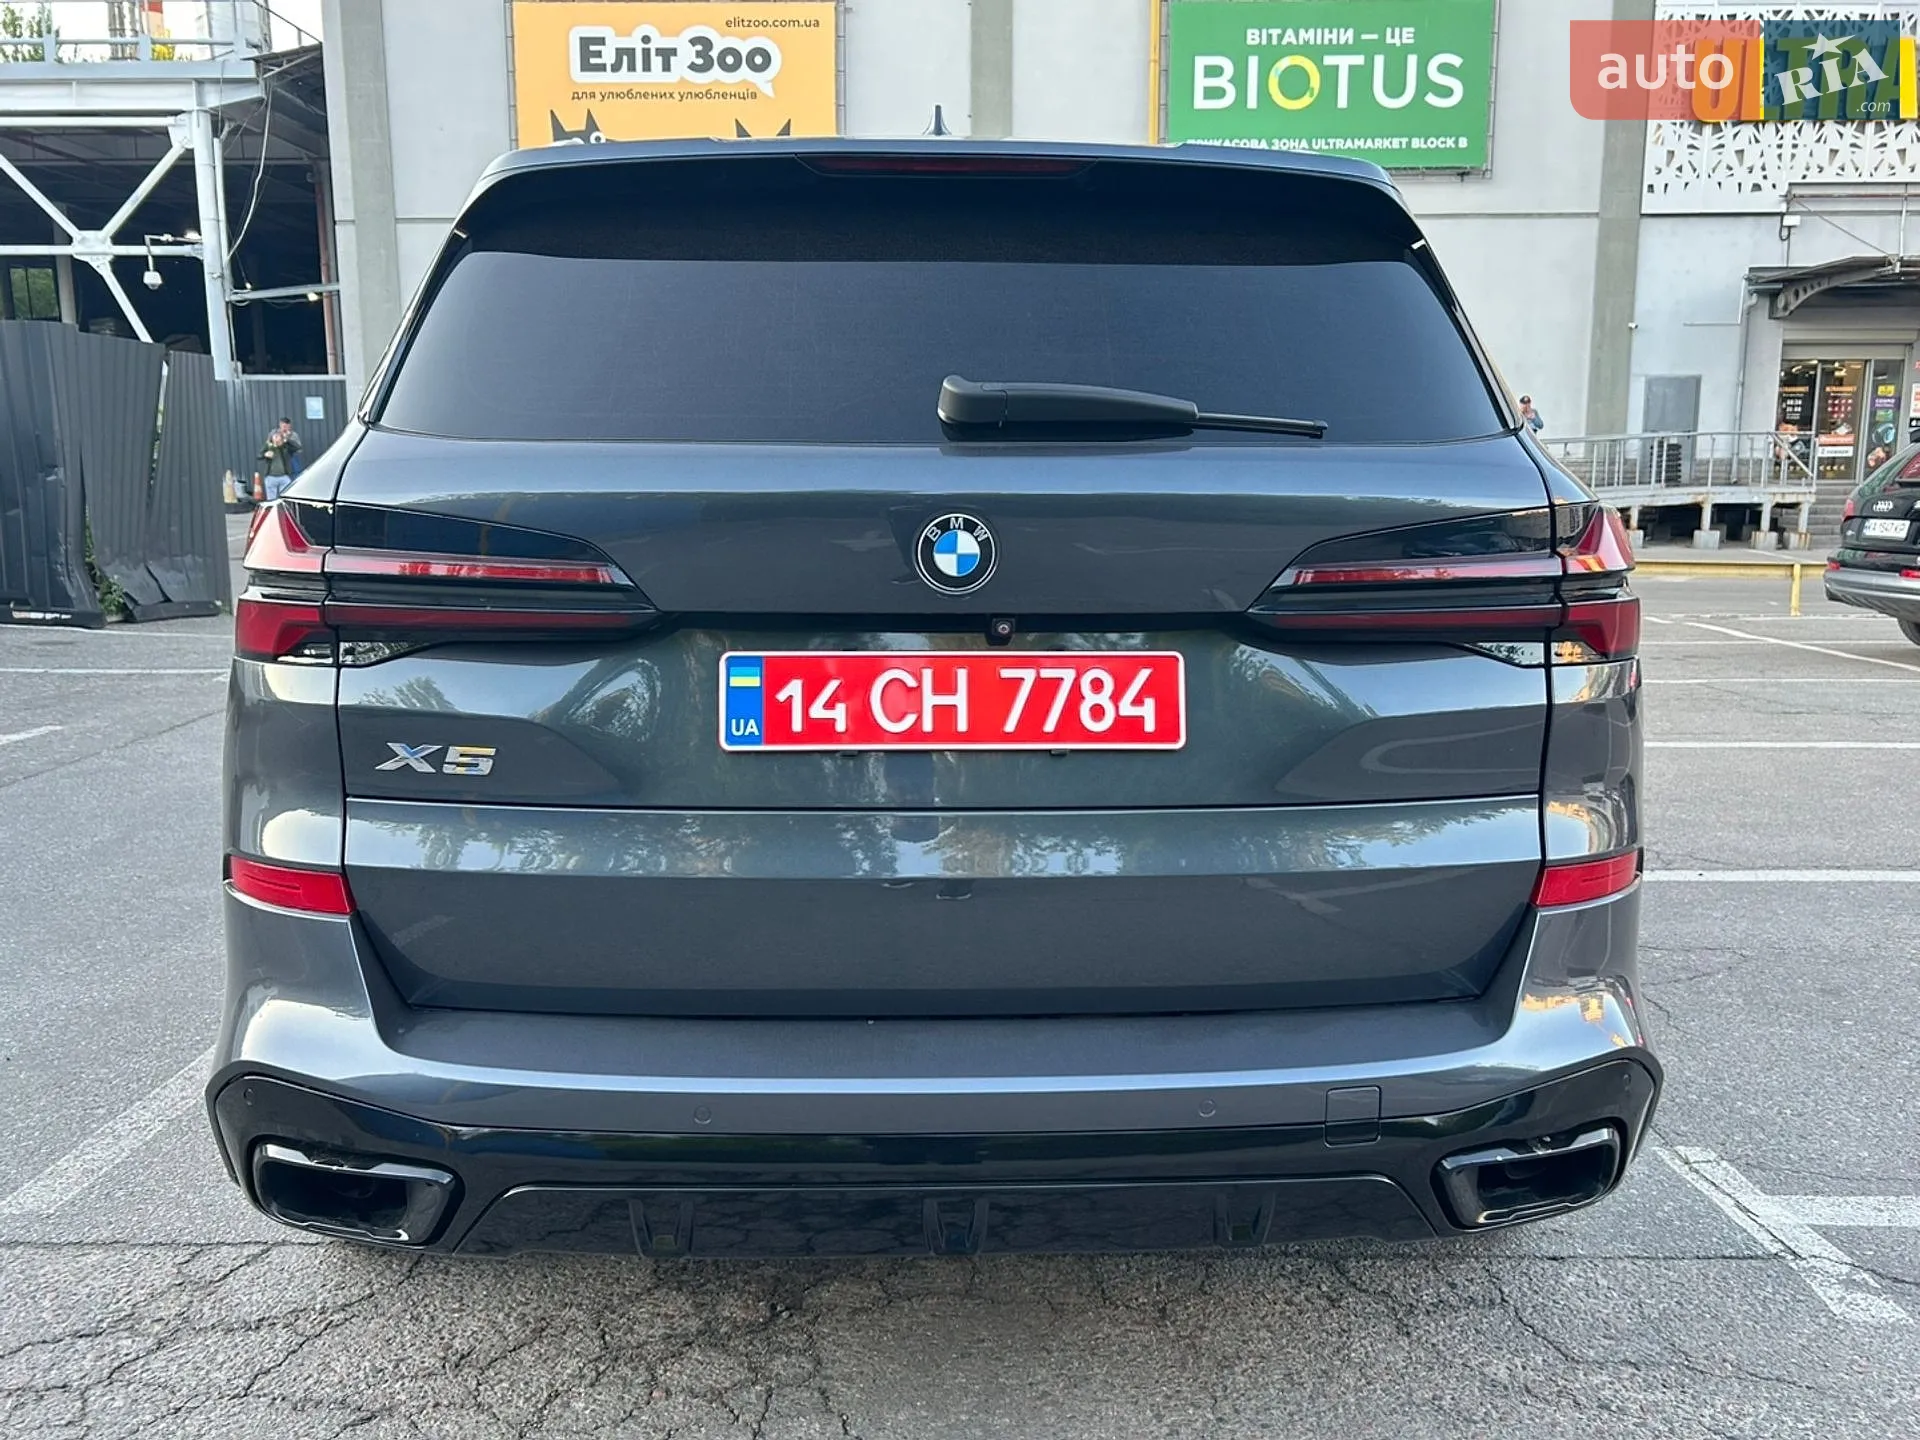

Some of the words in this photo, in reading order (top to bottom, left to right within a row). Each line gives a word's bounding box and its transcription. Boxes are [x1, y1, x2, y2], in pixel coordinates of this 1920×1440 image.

[725, 17, 820, 28] elitzoo.com.ua
[1246, 28, 1354, 46] ВІТАМІНИ
[1385, 27, 1416, 46] ЦЕ
[579, 35, 678, 73] Еліт
[686, 36, 772, 74] Зоо
[1193, 53, 1465, 110] BIOTUS
[571, 91, 596, 101] для
[600, 89, 675, 102] улюблених
[678, 88, 758, 102] улюбленців
[1272, 138, 1309, 150] ЗОНА
[1312, 137, 1408, 149] ULTRAMARKET
[1411, 137, 1455, 148] BLOCK
[775, 678, 847, 733] 14
[869, 668, 968, 733] CH
[999, 667, 1156, 733] 7784
[731, 719, 760, 737] UA
[375, 742, 496, 775] X5
